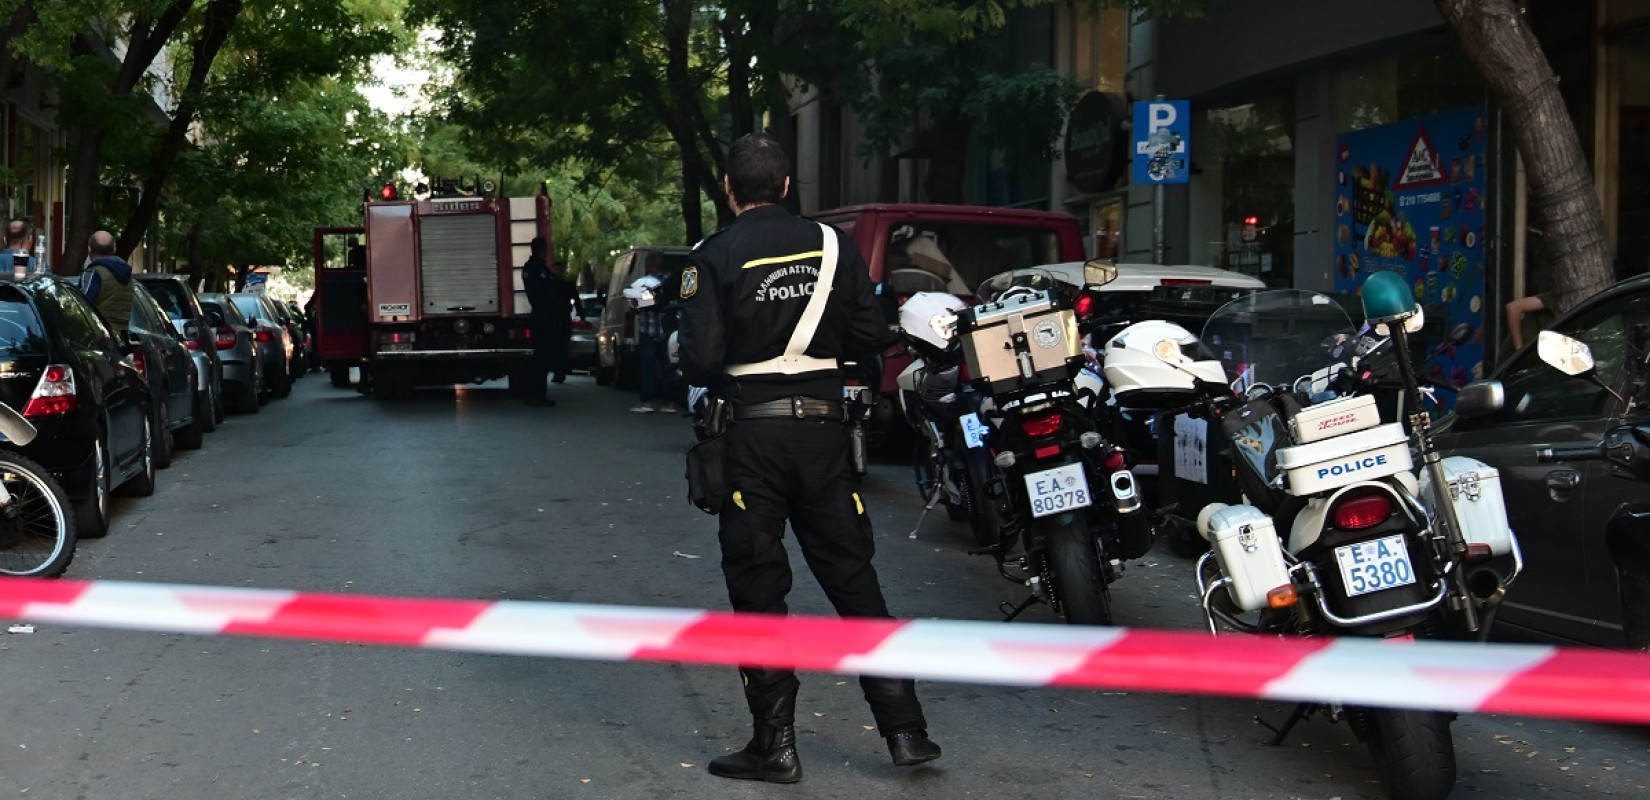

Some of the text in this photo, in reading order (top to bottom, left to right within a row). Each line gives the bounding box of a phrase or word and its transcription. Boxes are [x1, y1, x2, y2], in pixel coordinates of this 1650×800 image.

[1149, 104, 1177, 143] P
[1317, 454, 1387, 479] POLICE
[1033, 489, 1086, 513] 80378
[1351, 557, 1409, 592] 5380
